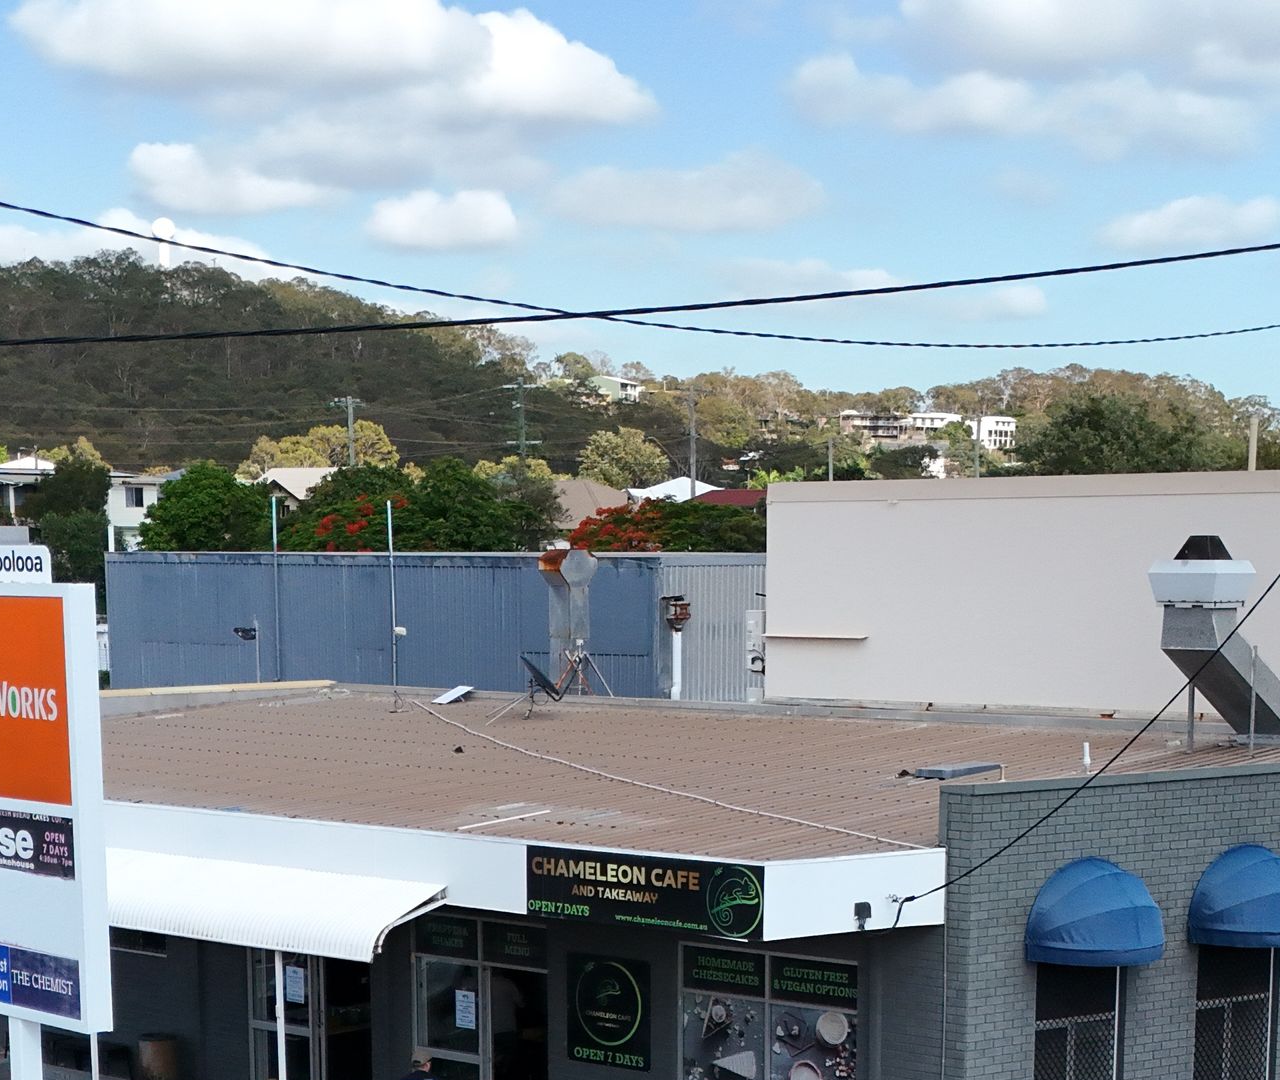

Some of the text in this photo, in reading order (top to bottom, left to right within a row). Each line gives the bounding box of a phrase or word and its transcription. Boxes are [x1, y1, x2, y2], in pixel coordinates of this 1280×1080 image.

[44, 831, 65, 844] OPEN
[42, 843, 68, 857] 7 DAYS
[531, 856, 700, 891] CHAMELEON CAFE
[572, 884, 658, 904] AND TAKEAWAY
[528, 900, 590, 917] OPEN 7 DAYS
[615, 914, 708, 931] www.chameleoncafe.com.au
[698, 956, 754, 972] HOMEMADE
[12, 970, 73, 996] THE CHEMIST
[692, 969, 759, 986] CHEESECAKES
[784, 967, 848, 984] GLUTEN FREE
[774, 979, 858, 998] & VEGAN OPTIONS
[574, 1046, 644, 1067] OPEN 7 DAYS
